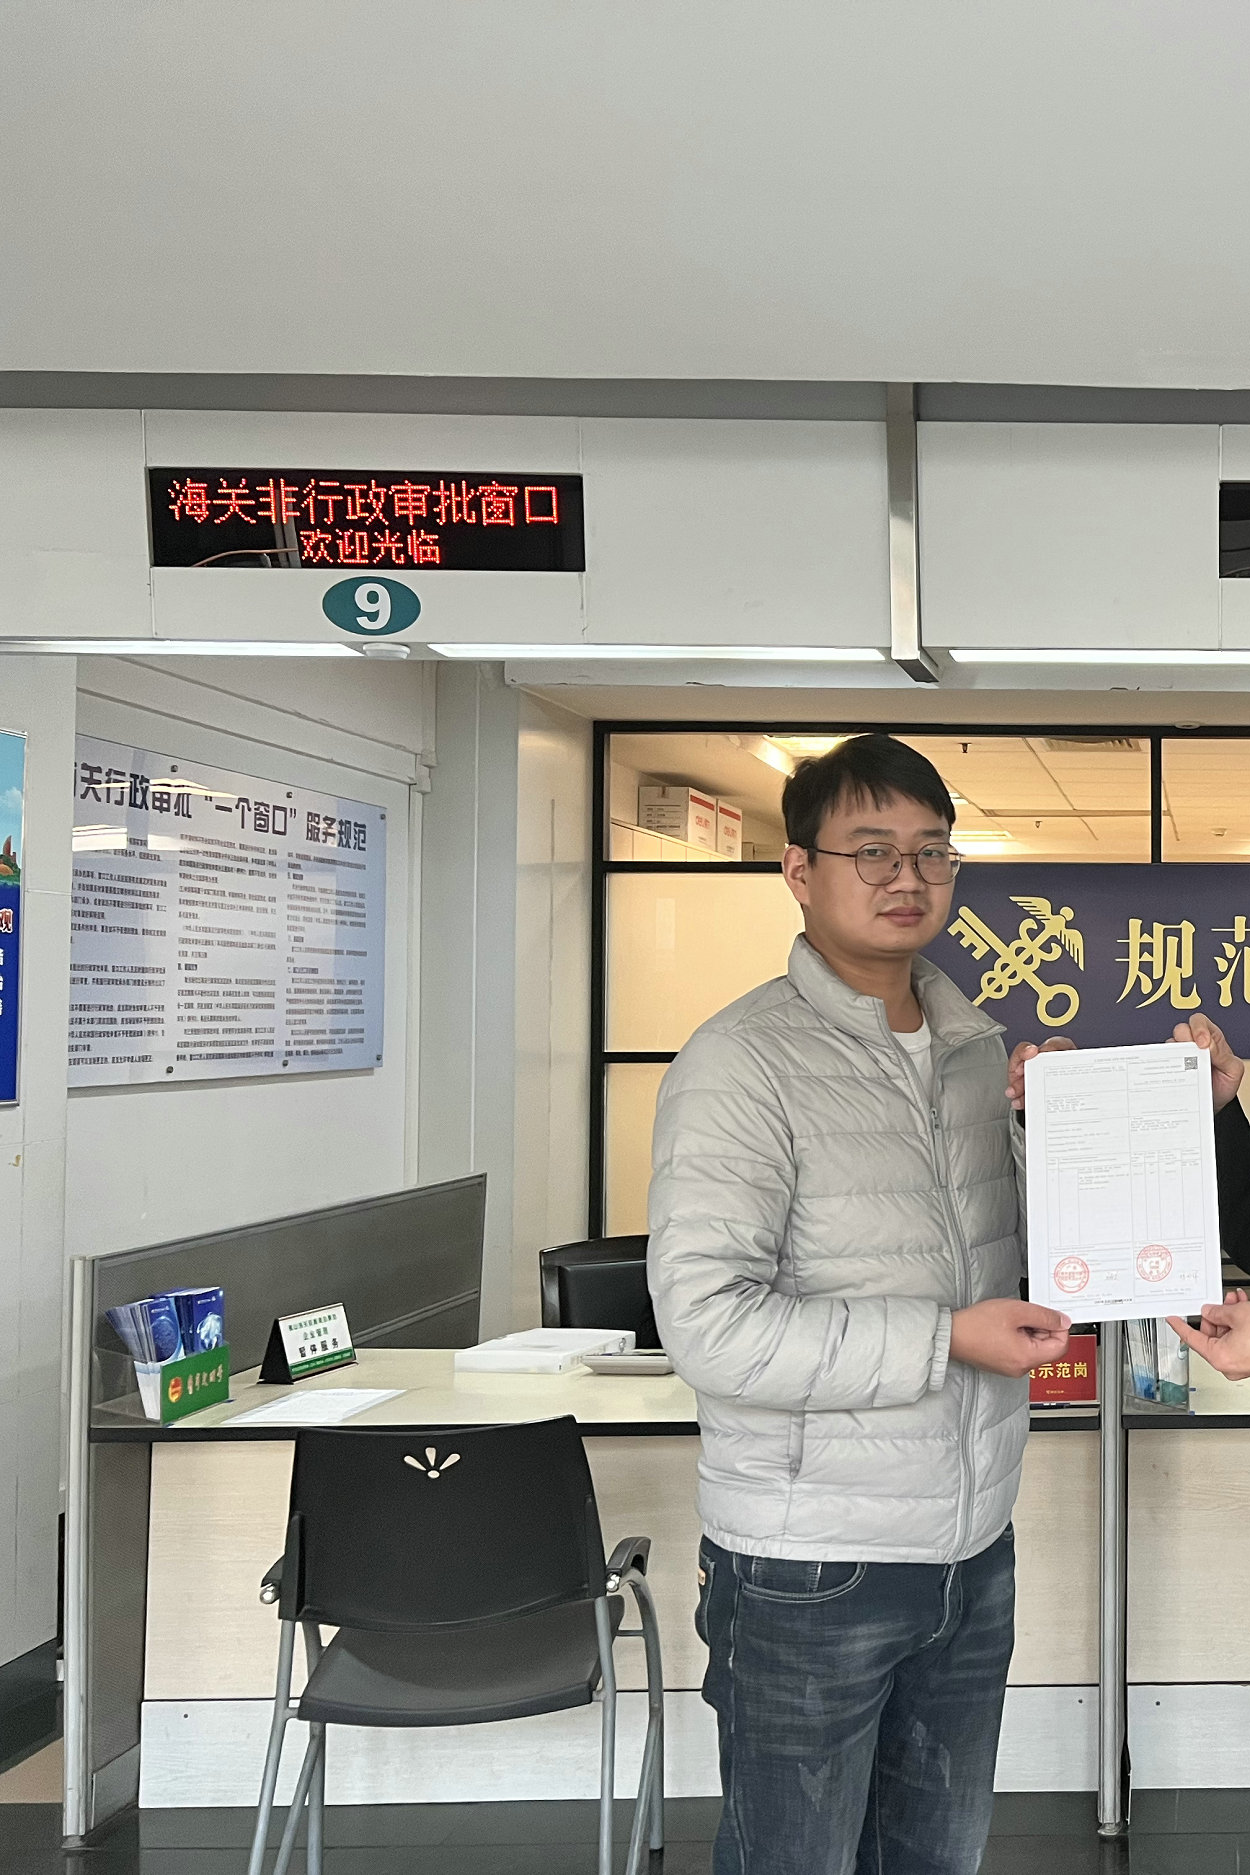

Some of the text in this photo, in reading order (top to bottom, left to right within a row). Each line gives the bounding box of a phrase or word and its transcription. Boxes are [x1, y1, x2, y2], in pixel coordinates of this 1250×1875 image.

[168, 478, 560, 526] 海关非行政审批窗口
[299, 528, 442, 565] 欢迎光临
[353, 582, 393, 631] 9
[73, 762, 367, 852] 关行政审批“一个窗口”服务规范
[298, 1337, 339, 1358] 暂停服务
